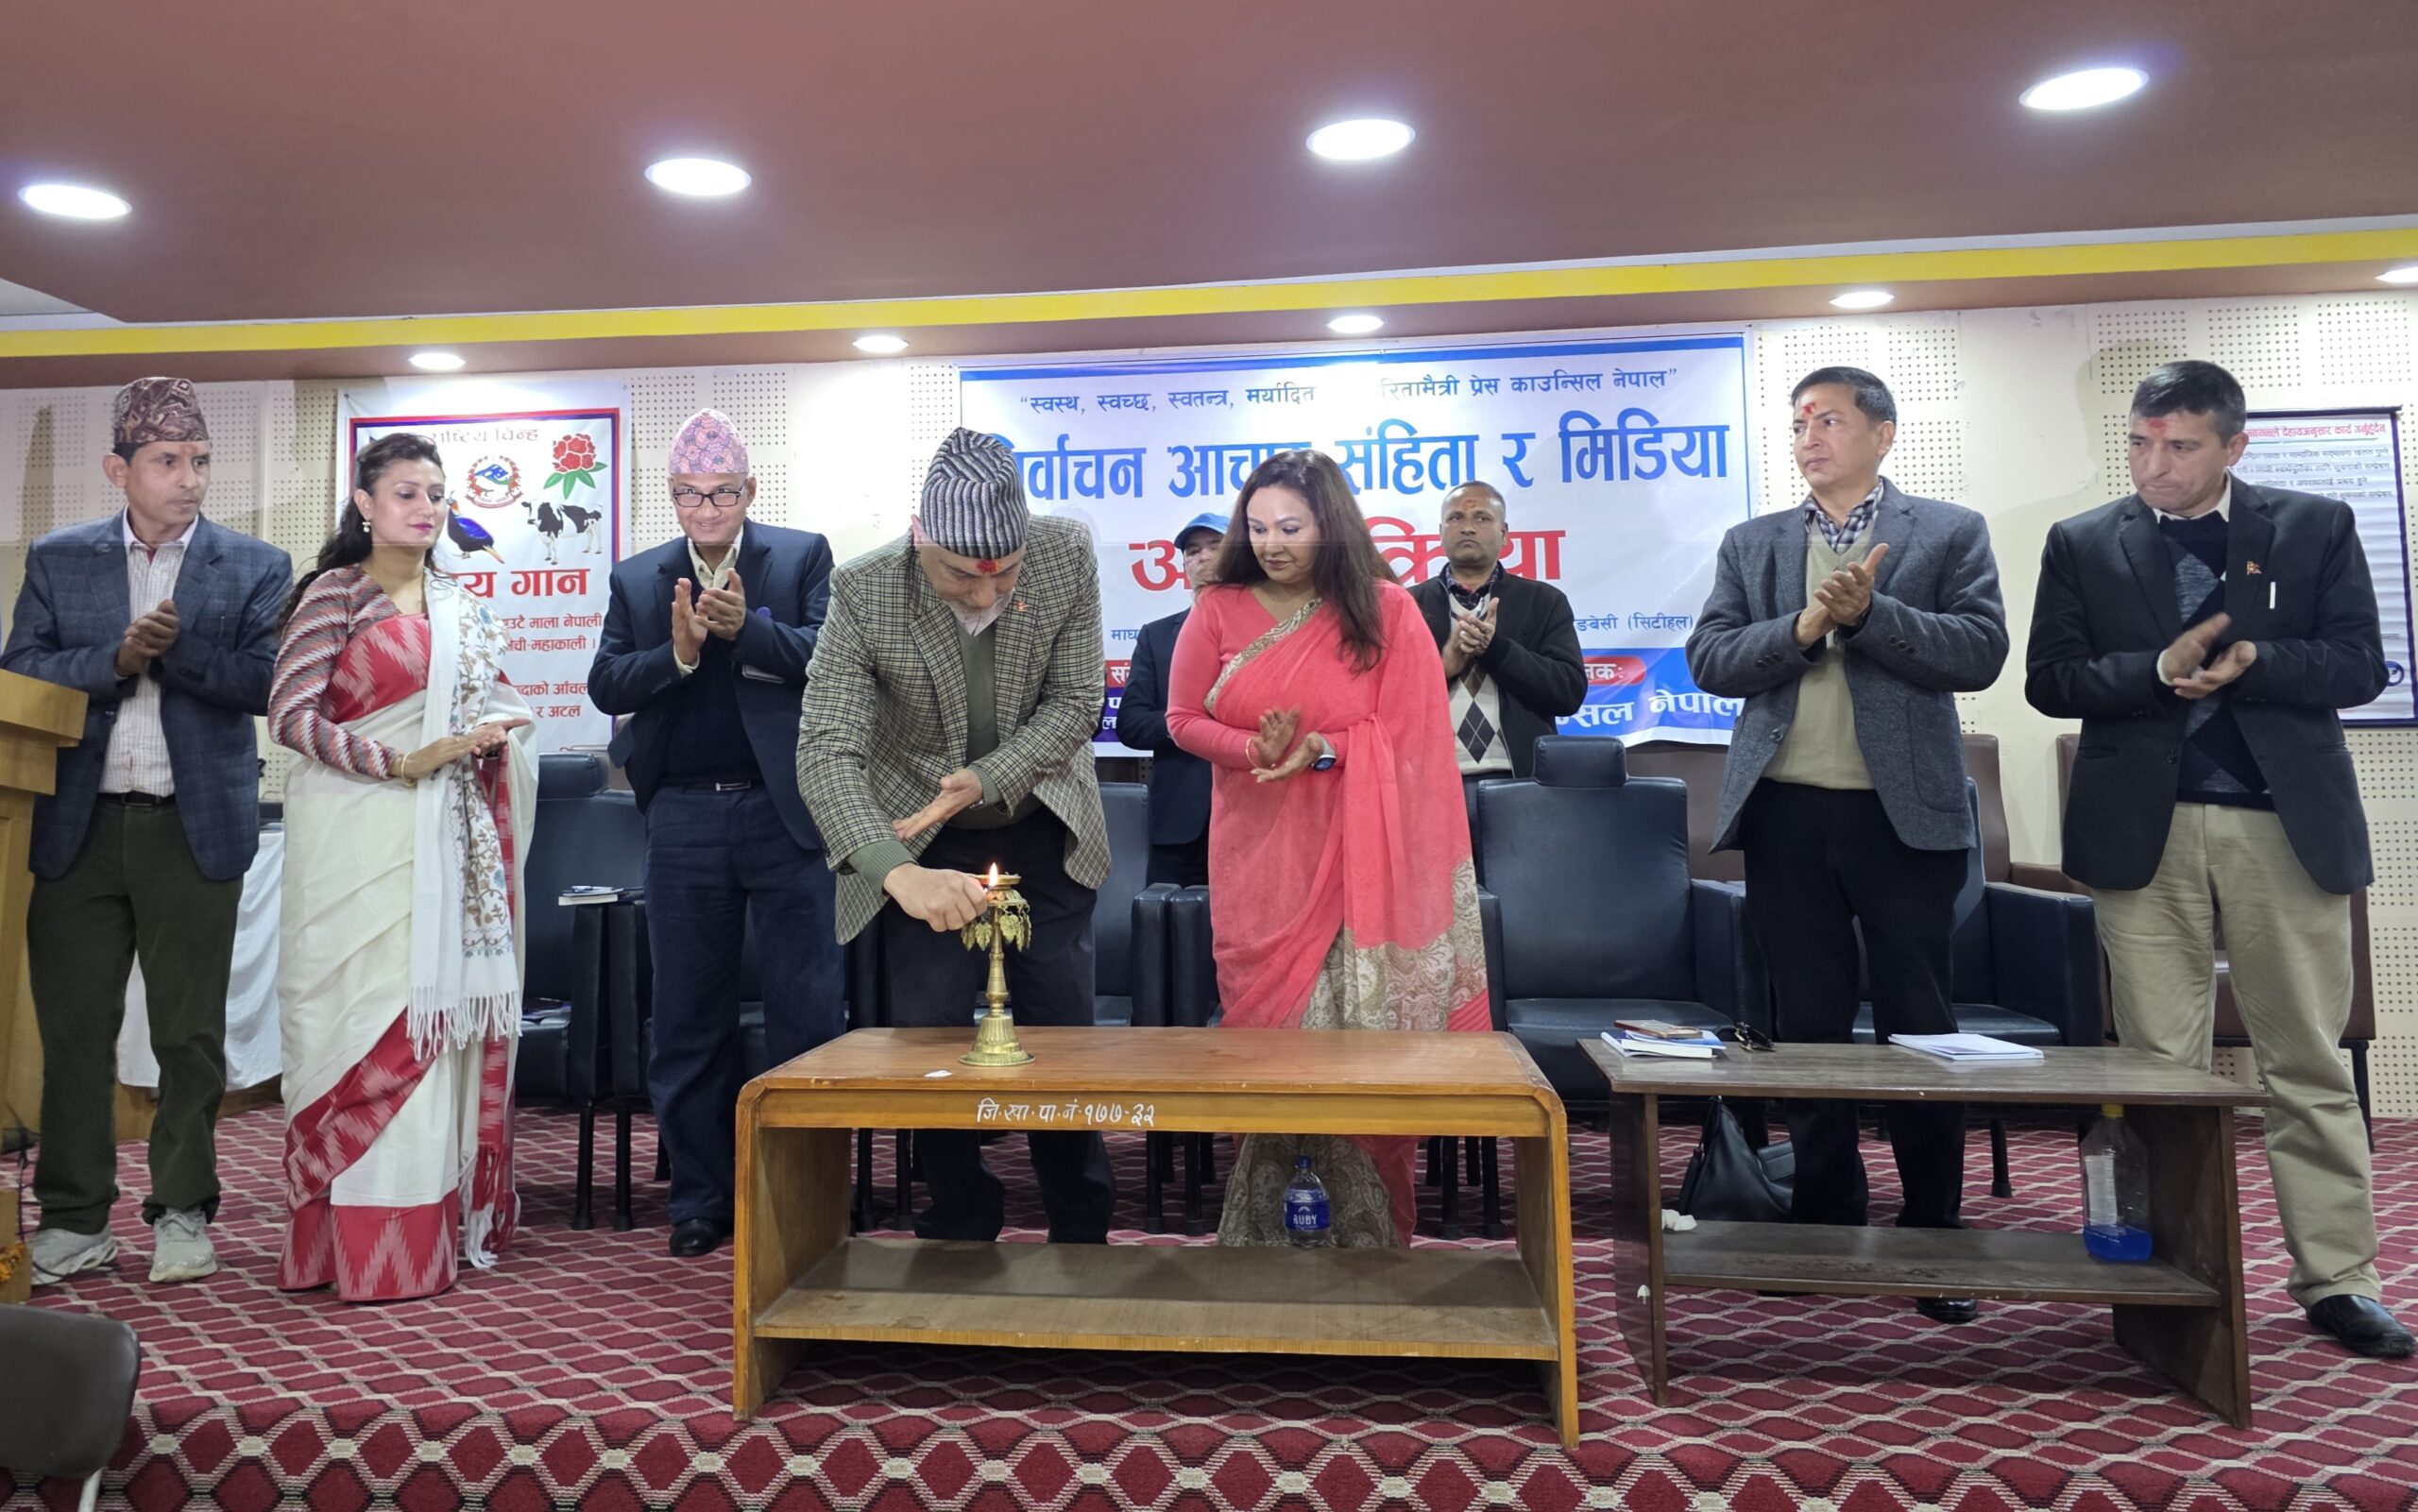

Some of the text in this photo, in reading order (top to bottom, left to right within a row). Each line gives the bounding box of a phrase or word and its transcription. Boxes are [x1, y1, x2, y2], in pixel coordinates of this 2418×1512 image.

[1097, 392, 1156, 413] स्वच्छ,
[1167, 389, 1234, 409] स्वतन्त्र,
[1246, 382, 1316, 404] मर्यादित
[1375, 373, 1460, 399] रितामैत्री
[1470, 374, 1500, 398] प्रेस
[1509, 368, 1603, 393] काउन्सिल
[986, 407, 1730, 501] र्वाचन आच संहिता र मिडिया
[510, 569, 590, 597] गान
[529, 617, 559, 629] माला
[563, 612, 603, 628] नेपाली
[1627, 612, 1694, 632] (सिटीहल)
[536, 705, 582, 718] र अटल
[1647, 689, 1745, 717] नेपाल
[1293, 1214, 1318, 1226] RUBY
